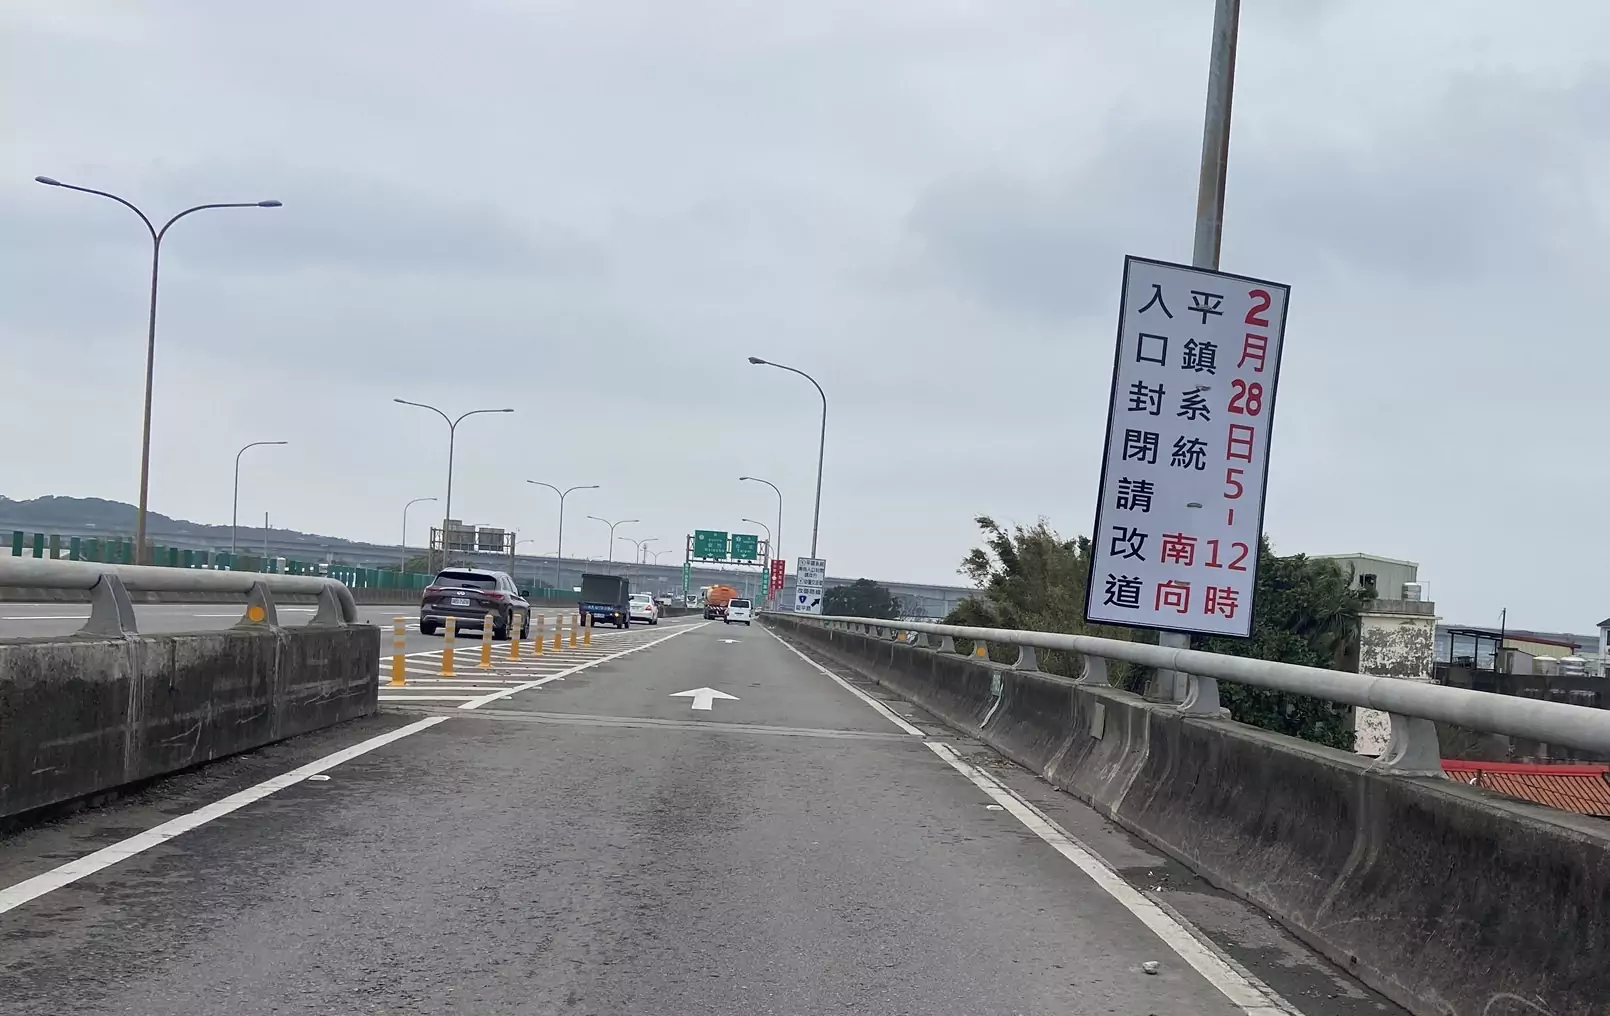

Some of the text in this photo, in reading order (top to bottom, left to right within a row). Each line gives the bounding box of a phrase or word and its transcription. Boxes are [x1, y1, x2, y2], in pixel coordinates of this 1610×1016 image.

[1103, 283, 1174, 609] 入口封閉請改道
[1170, 289, 1225, 471] 平鎮系統
[1153, 532, 1198, 614] 南向
